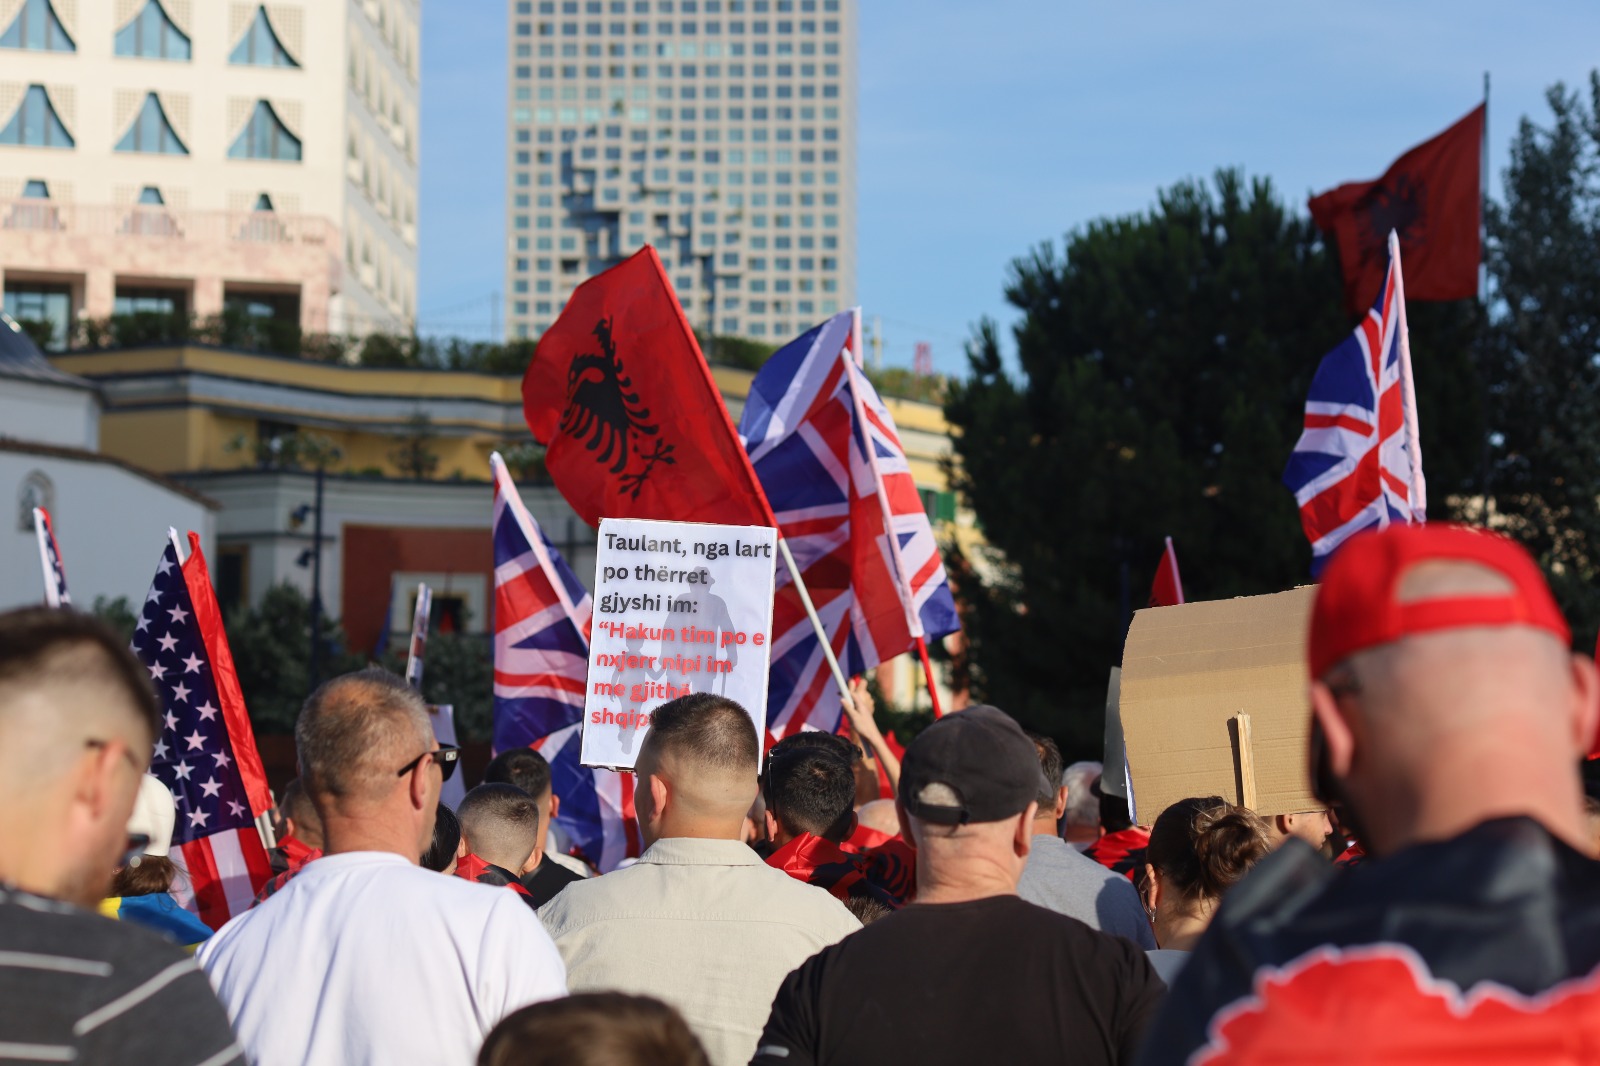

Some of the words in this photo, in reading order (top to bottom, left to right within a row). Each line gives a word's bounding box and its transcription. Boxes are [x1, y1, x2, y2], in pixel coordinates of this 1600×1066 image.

[605, 533, 687, 557] Taulant,
[694, 542, 729, 560] nga
[735, 540, 771, 558] lart
[603, 565, 628, 583] po
[635, 564, 708, 584] thërret
[600, 592, 660, 613] gjyshi
[667, 595, 698, 613] im:
[681, 626, 714, 643] tim
[721, 631, 746, 648] po
[753, 633, 764, 645] e
[596, 651, 656, 672] nxjerr
[662, 654, 700, 675] nipi
[707, 656, 732, 673] im
[594, 683, 625, 696] me
[630, 682, 690, 703] gjithë
